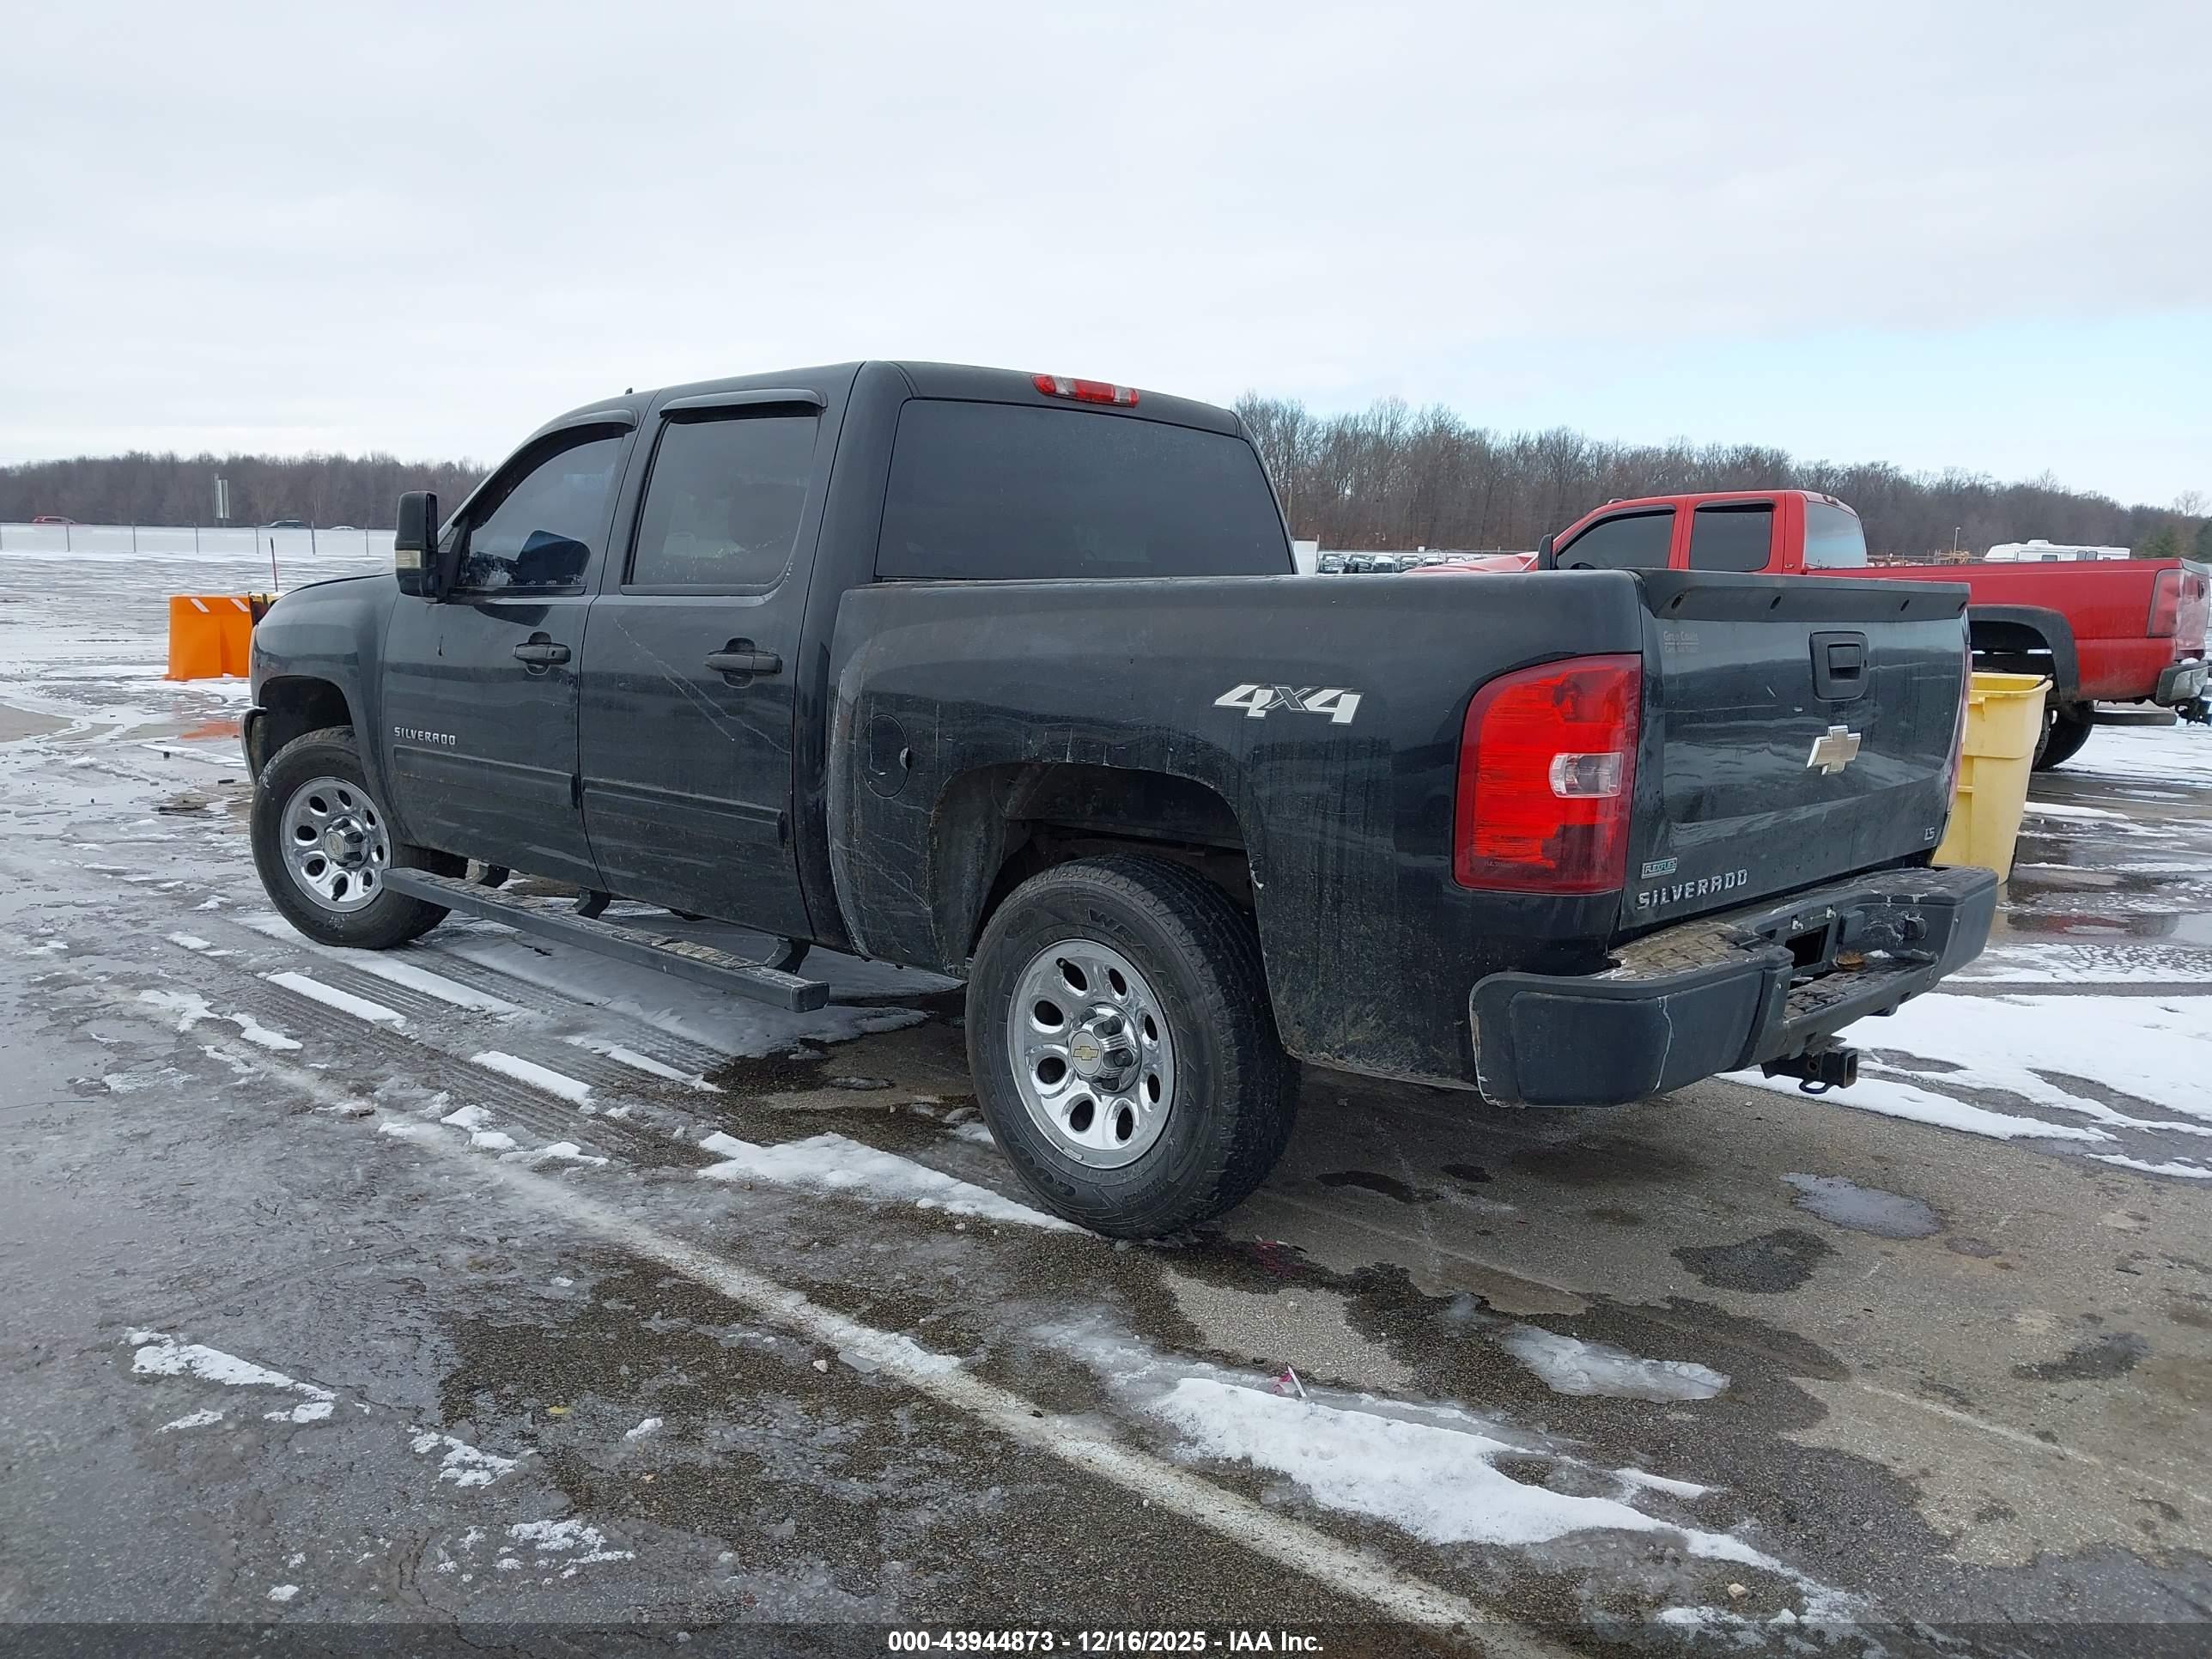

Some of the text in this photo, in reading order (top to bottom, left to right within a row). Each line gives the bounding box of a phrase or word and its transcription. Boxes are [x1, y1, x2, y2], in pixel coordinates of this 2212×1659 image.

[393, 726, 456, 745] SILVERADO
[1924, 826, 1936, 841] LS
[1636, 868, 1748, 910] SILVERADO
